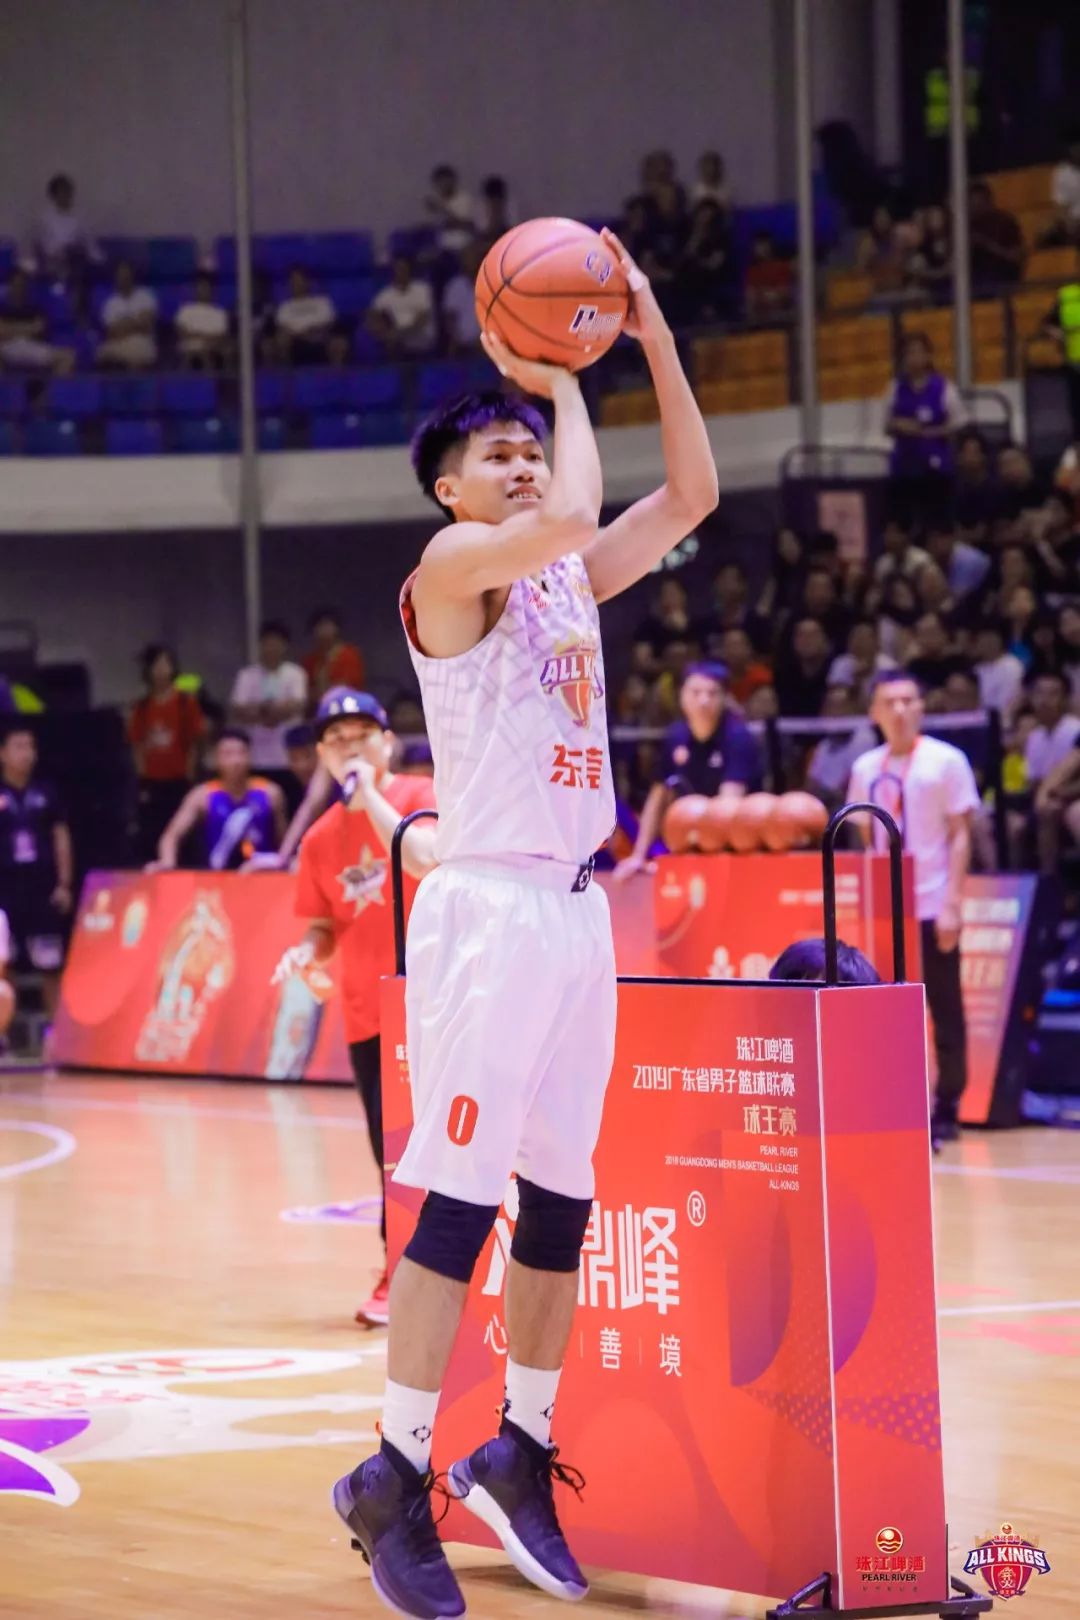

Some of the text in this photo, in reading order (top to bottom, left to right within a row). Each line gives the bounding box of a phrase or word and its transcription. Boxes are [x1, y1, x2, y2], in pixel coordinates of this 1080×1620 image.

[542, 656, 581, 684] ALL
[736, 1036, 794, 1063] 珠江啤酒
[632, 1065, 796, 1096] 2019广东省男子篮球联赛
[447, 1095, 479, 1146] 0
[743, 1103, 797, 1137] 球王赛
[759, 1145, 779, 1156] PEARL
[680, 1156, 718, 1168] GUANGDONG
[737, 1161, 774, 1173] BASKETBALL
[774, 1163, 799, 1175] LEAGUE
